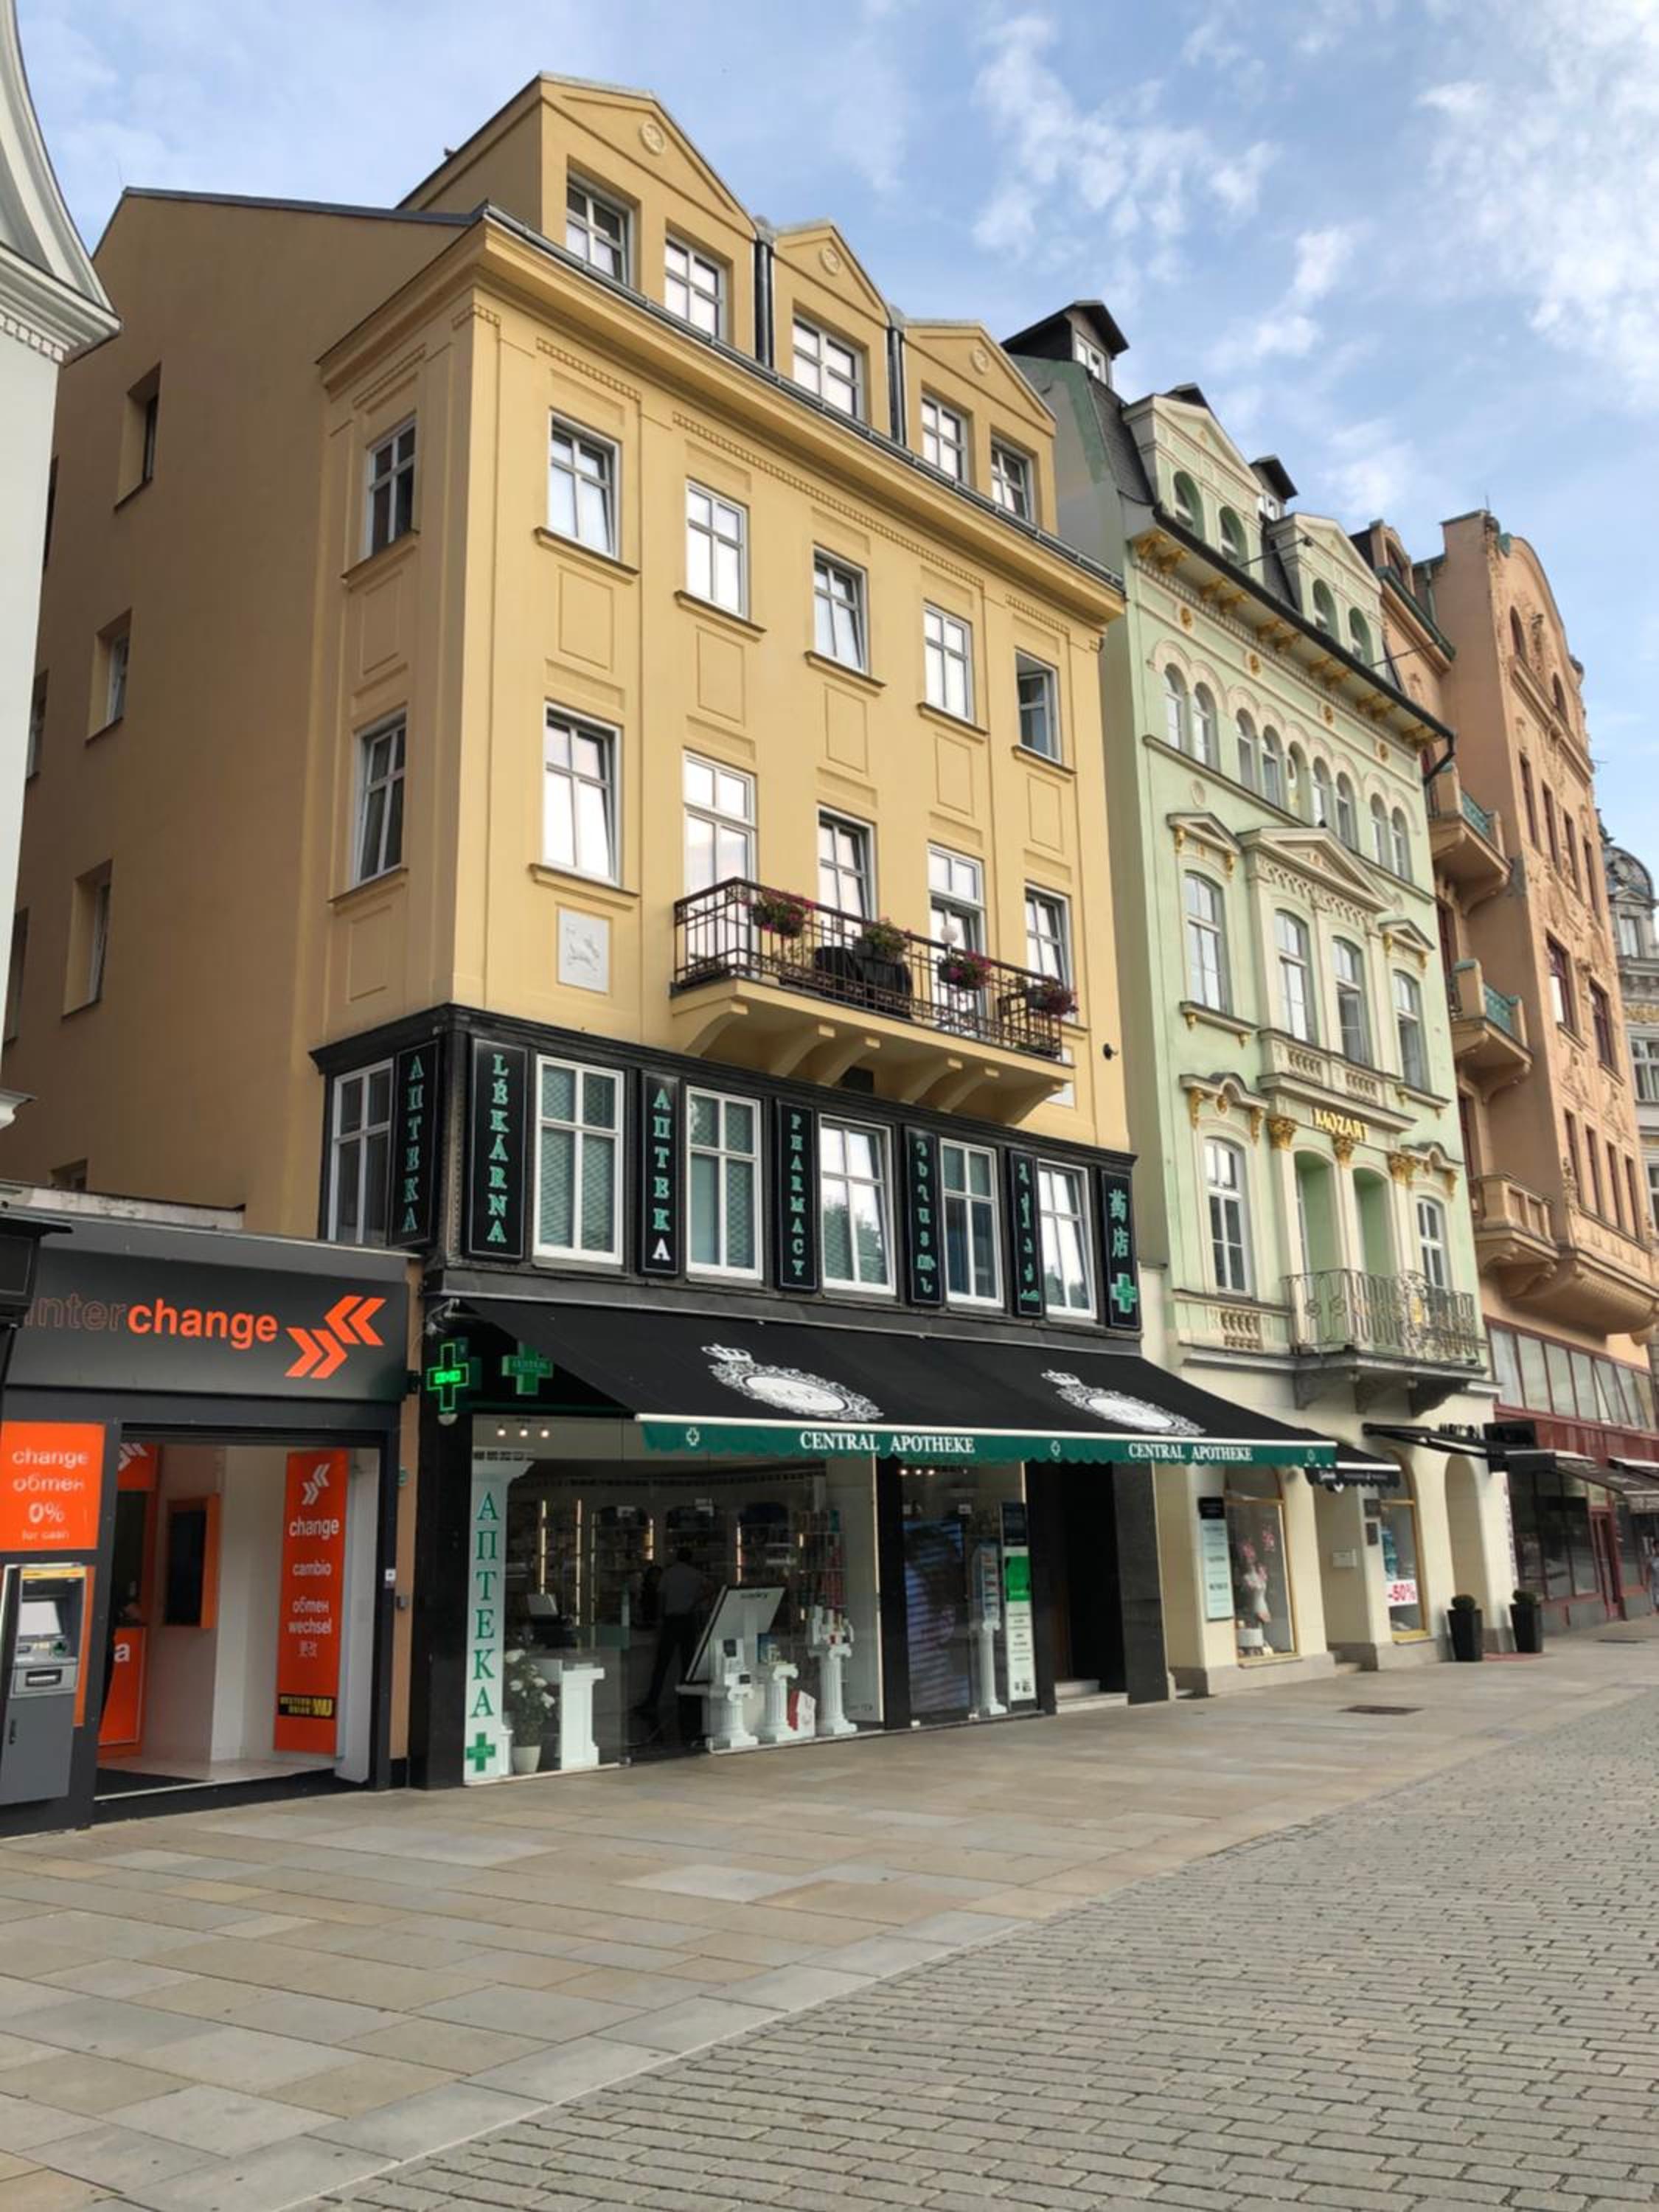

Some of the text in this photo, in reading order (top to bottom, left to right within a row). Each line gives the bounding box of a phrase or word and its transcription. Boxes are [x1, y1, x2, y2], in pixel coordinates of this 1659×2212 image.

[487, 1054, 509, 1243] LÉKÁRNA
[653, 1088, 671, 1261] АПТЕКА
[790, 1114, 804, 1276] PHARMACY
[800, 1430, 975, 1453] CENTRAL APOTHEKE
[1128, 1442, 1253, 1461] CENTRAL APOTHEKE
[12, 1447, 89, 1469] change
[29, 1502, 65, 1524] 0%
[289, 1517, 339, 1540] change
[293, 1559, 331, 1576] cambio
[1388, 1584, 1416, 1601] -50%
[470, 1492, 500, 1718] АПТЕКА
[288, 1618, 332, 1635] wechsel
